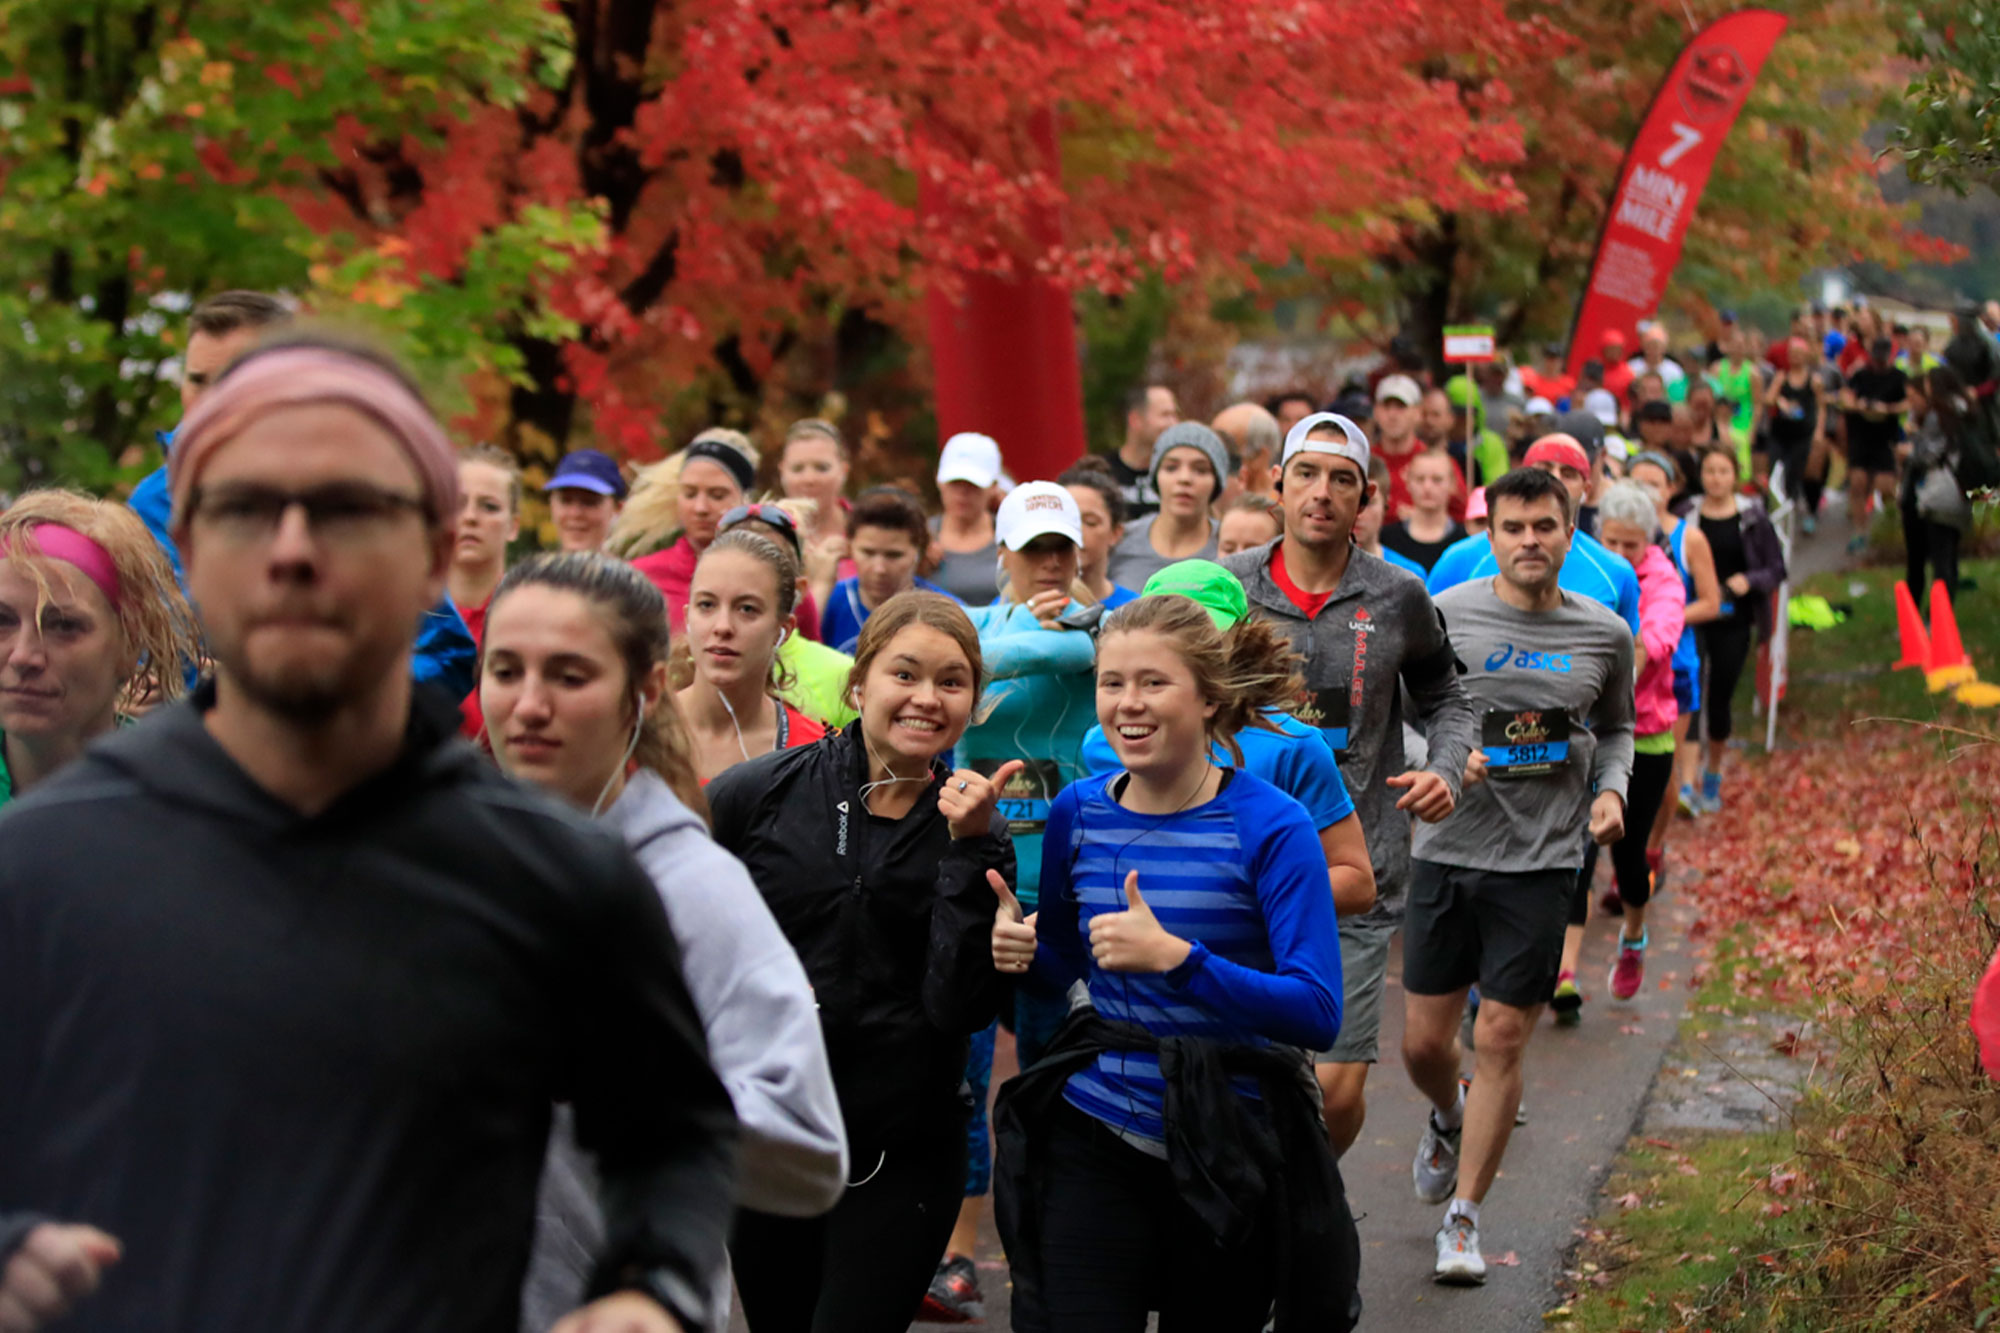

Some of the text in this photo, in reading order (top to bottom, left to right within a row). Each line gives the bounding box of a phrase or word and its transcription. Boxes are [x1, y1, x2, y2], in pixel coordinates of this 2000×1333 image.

[1658, 120, 1704, 168] 7
[1625, 163, 1688, 212] MIN
[1615, 197, 1676, 243] MILE
[1348, 621, 1375, 633] UCM
[1350, 631, 1368, 707] MULES
[1514, 650, 1573, 673] asics
[1292, 701, 1326, 720] ider
[1505, 720, 1550, 740] Cider
[1508, 744, 1549, 763] 5812
[836, 813, 848, 856] Reebok
